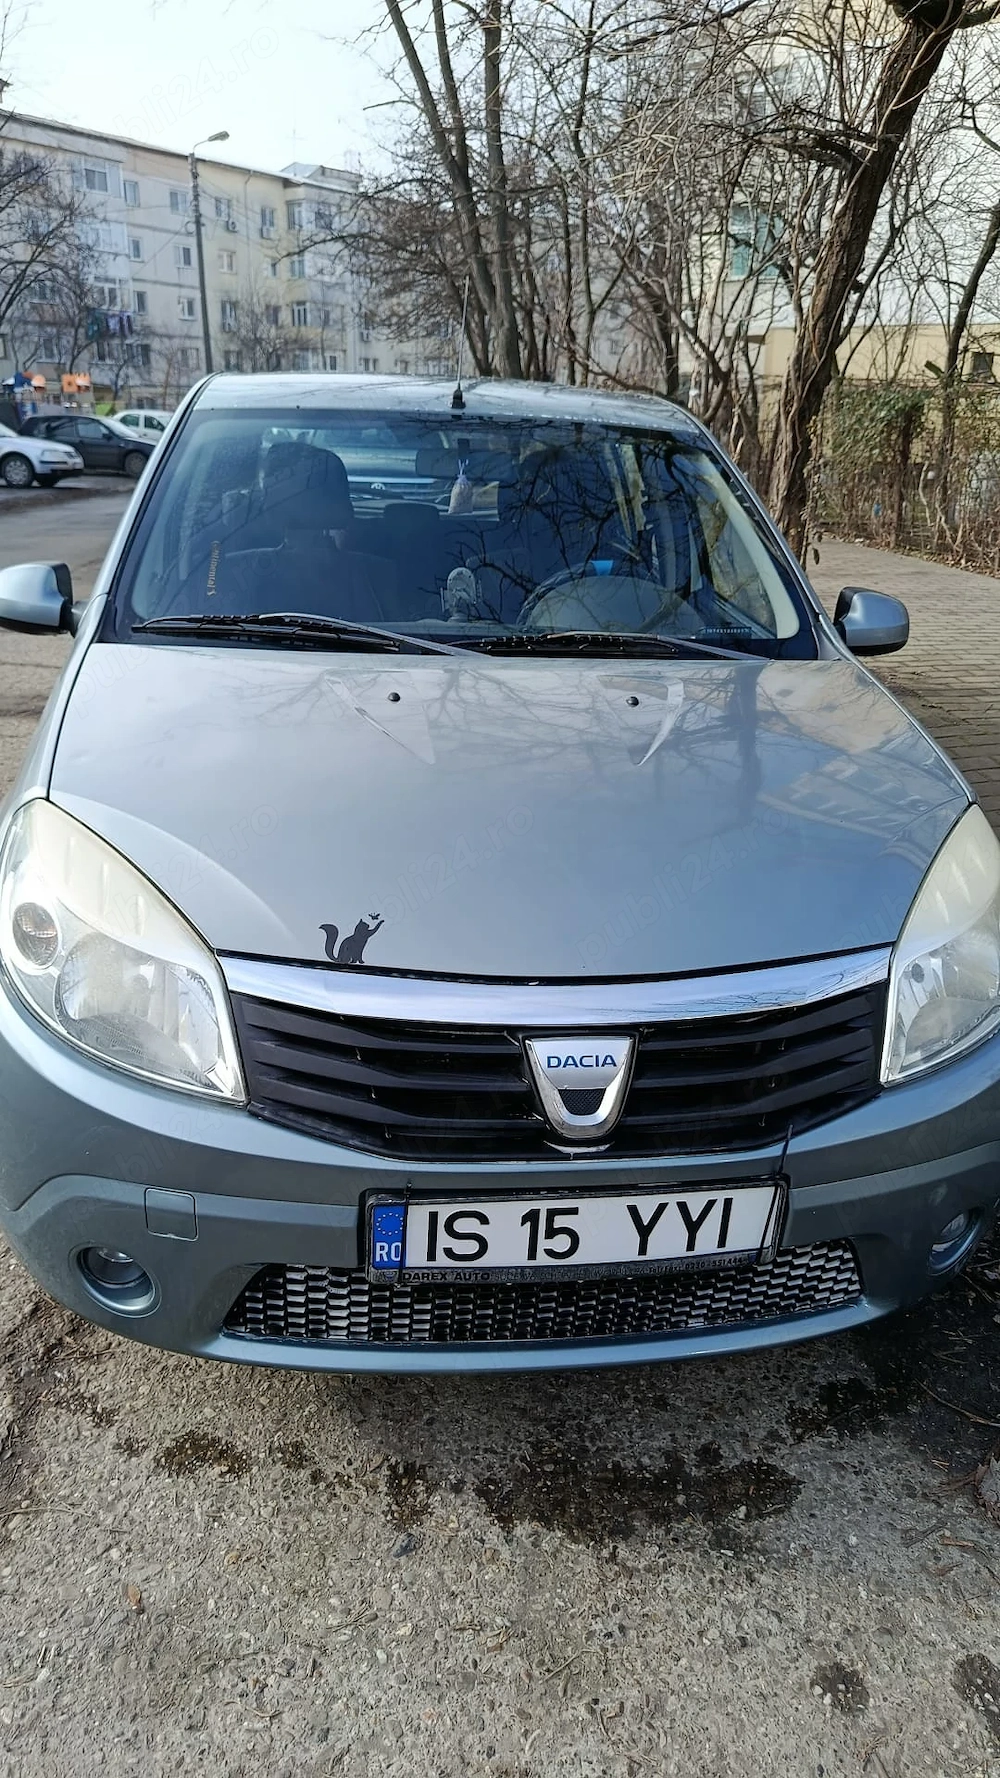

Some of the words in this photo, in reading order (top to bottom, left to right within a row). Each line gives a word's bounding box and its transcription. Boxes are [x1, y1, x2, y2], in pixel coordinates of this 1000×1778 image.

[546, 1055, 617, 1069] DACIA
[426, 1210, 490, 1262] IS
[520, 1206, 581, 1261] 15
[626, 1197, 735, 1256] YYI
[375, 1241, 402, 1262] RO
[402, 1271, 448, 1281] DAREX
[454, 1271, 491, 1281] AUTO
